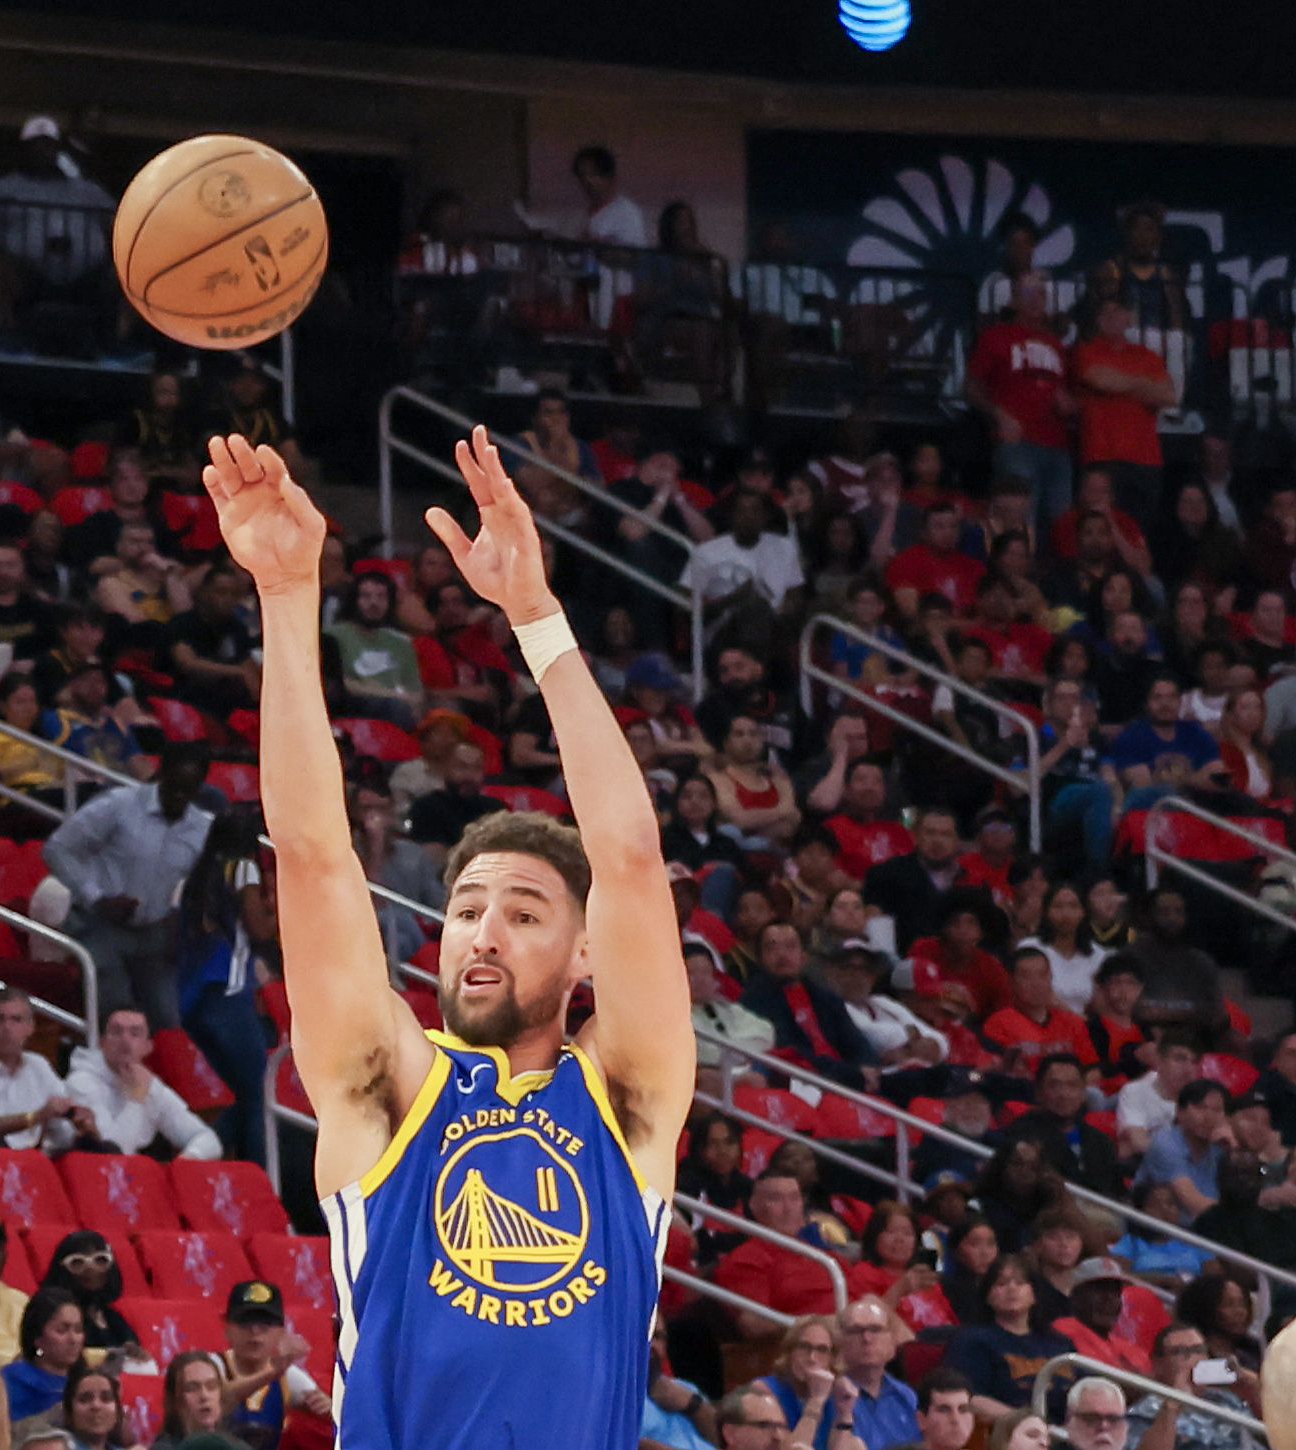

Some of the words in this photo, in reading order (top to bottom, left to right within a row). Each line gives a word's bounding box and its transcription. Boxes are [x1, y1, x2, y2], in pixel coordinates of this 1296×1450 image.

[440, 1108, 517, 1156] OLDEN
[522, 1107, 586, 1157] STATE
[536, 1166, 560, 1213] 11
[427, 1257, 609, 1328] WARRIORS
